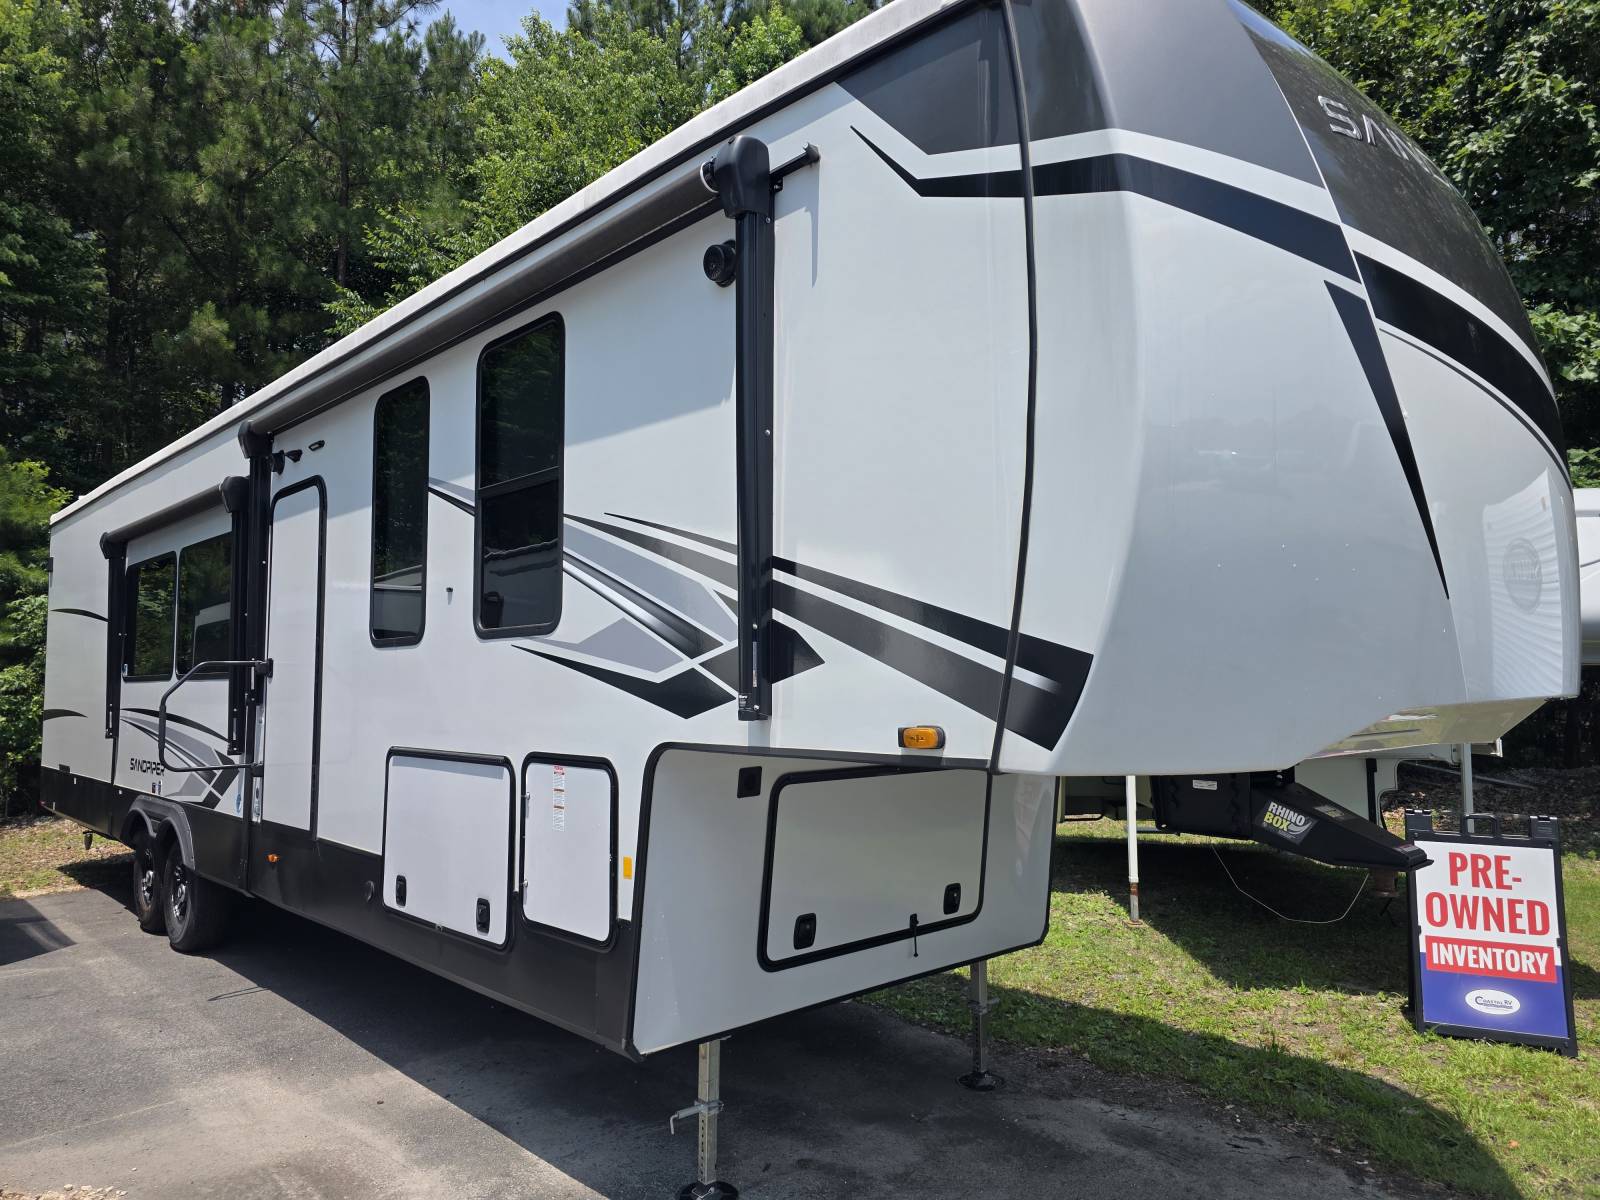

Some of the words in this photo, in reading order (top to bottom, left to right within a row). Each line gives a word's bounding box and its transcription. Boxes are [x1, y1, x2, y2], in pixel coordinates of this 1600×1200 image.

[130, 758, 165, 776] SANDPIPER
[1264, 811, 1291, 832] BOX
[1268, 801, 1306, 826] RHINO
[1448, 851, 1522, 891] PRE-
[1425, 891, 1550, 936] OWNED
[1432, 942, 1549, 976] INVENTORY
